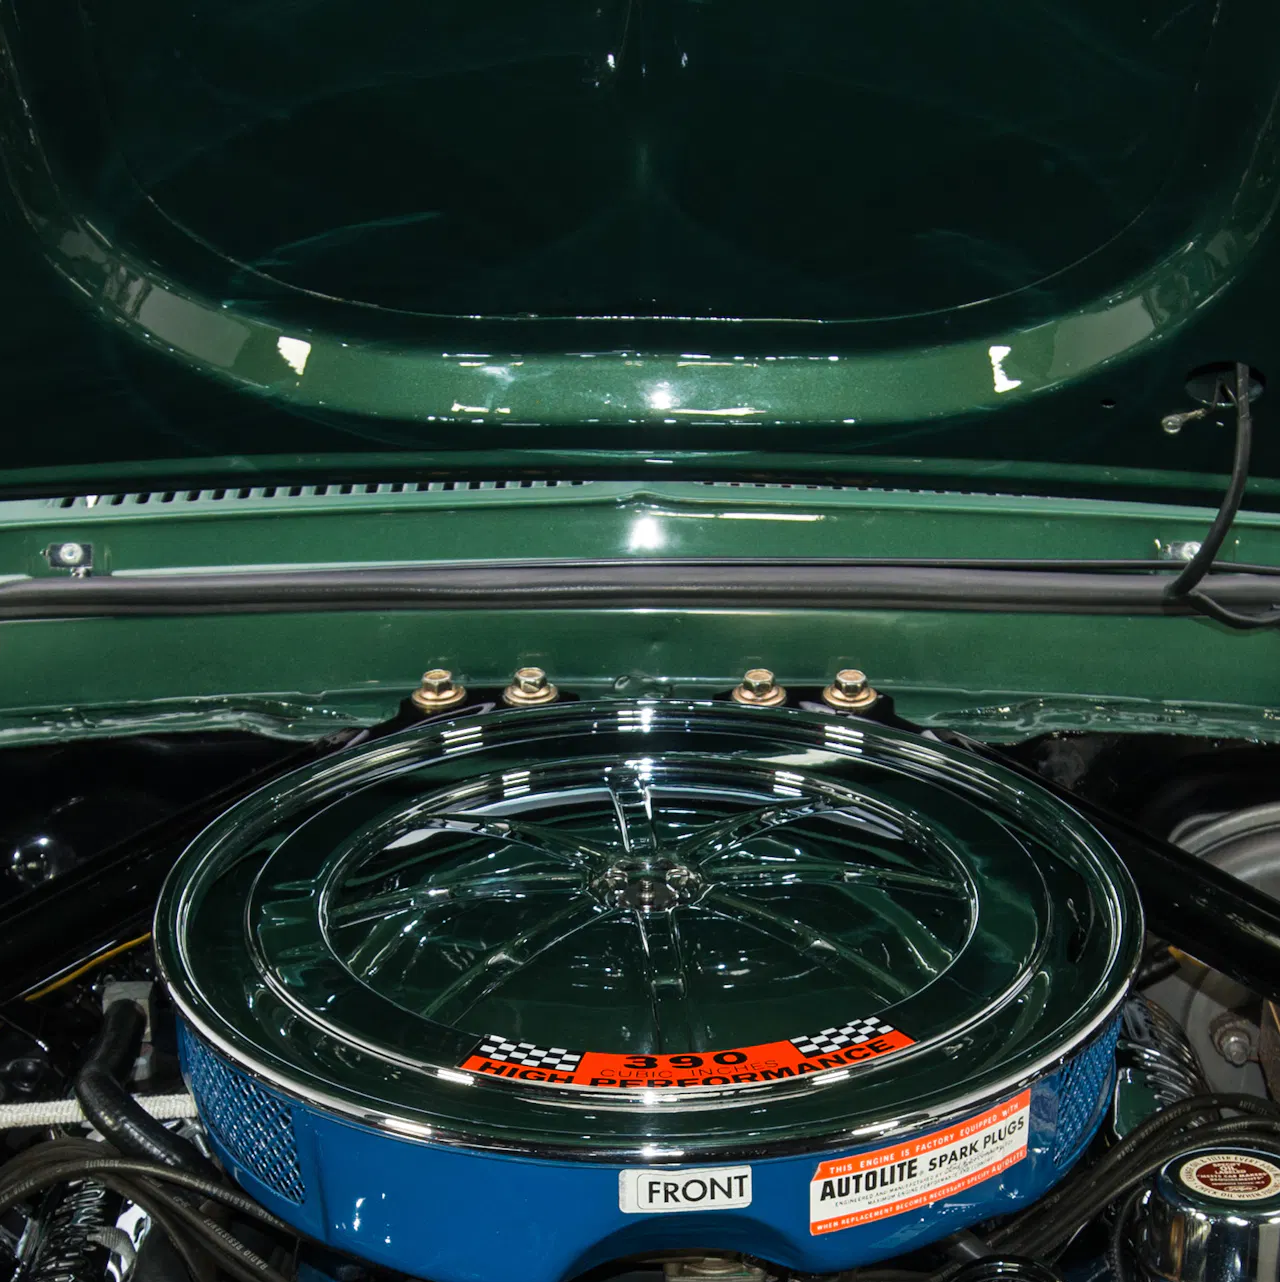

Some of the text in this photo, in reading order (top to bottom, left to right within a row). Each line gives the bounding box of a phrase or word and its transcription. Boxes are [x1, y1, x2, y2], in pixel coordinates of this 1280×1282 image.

[477, 1039, 896, 1087] HIGH PERFORMANCE
[600, 1060, 779, 1079] CUBIC INCHES
[623, 1051, 748, 1070] 390
[829, 1102, 1020, 1175] THIS ENGINE IS FACTORY EQUIPPED WITH
[819, 1115, 1024, 1202] AUTOLITE SPARK PLUGS
[648, 1174, 748, 1203] FRONT
[816, 1149, 1024, 1231] WHEN REPLACEMENT BECOMES NECESSARY SPECIFY AUTOLITE
[243, 1248, 269, 1271] RADIO
